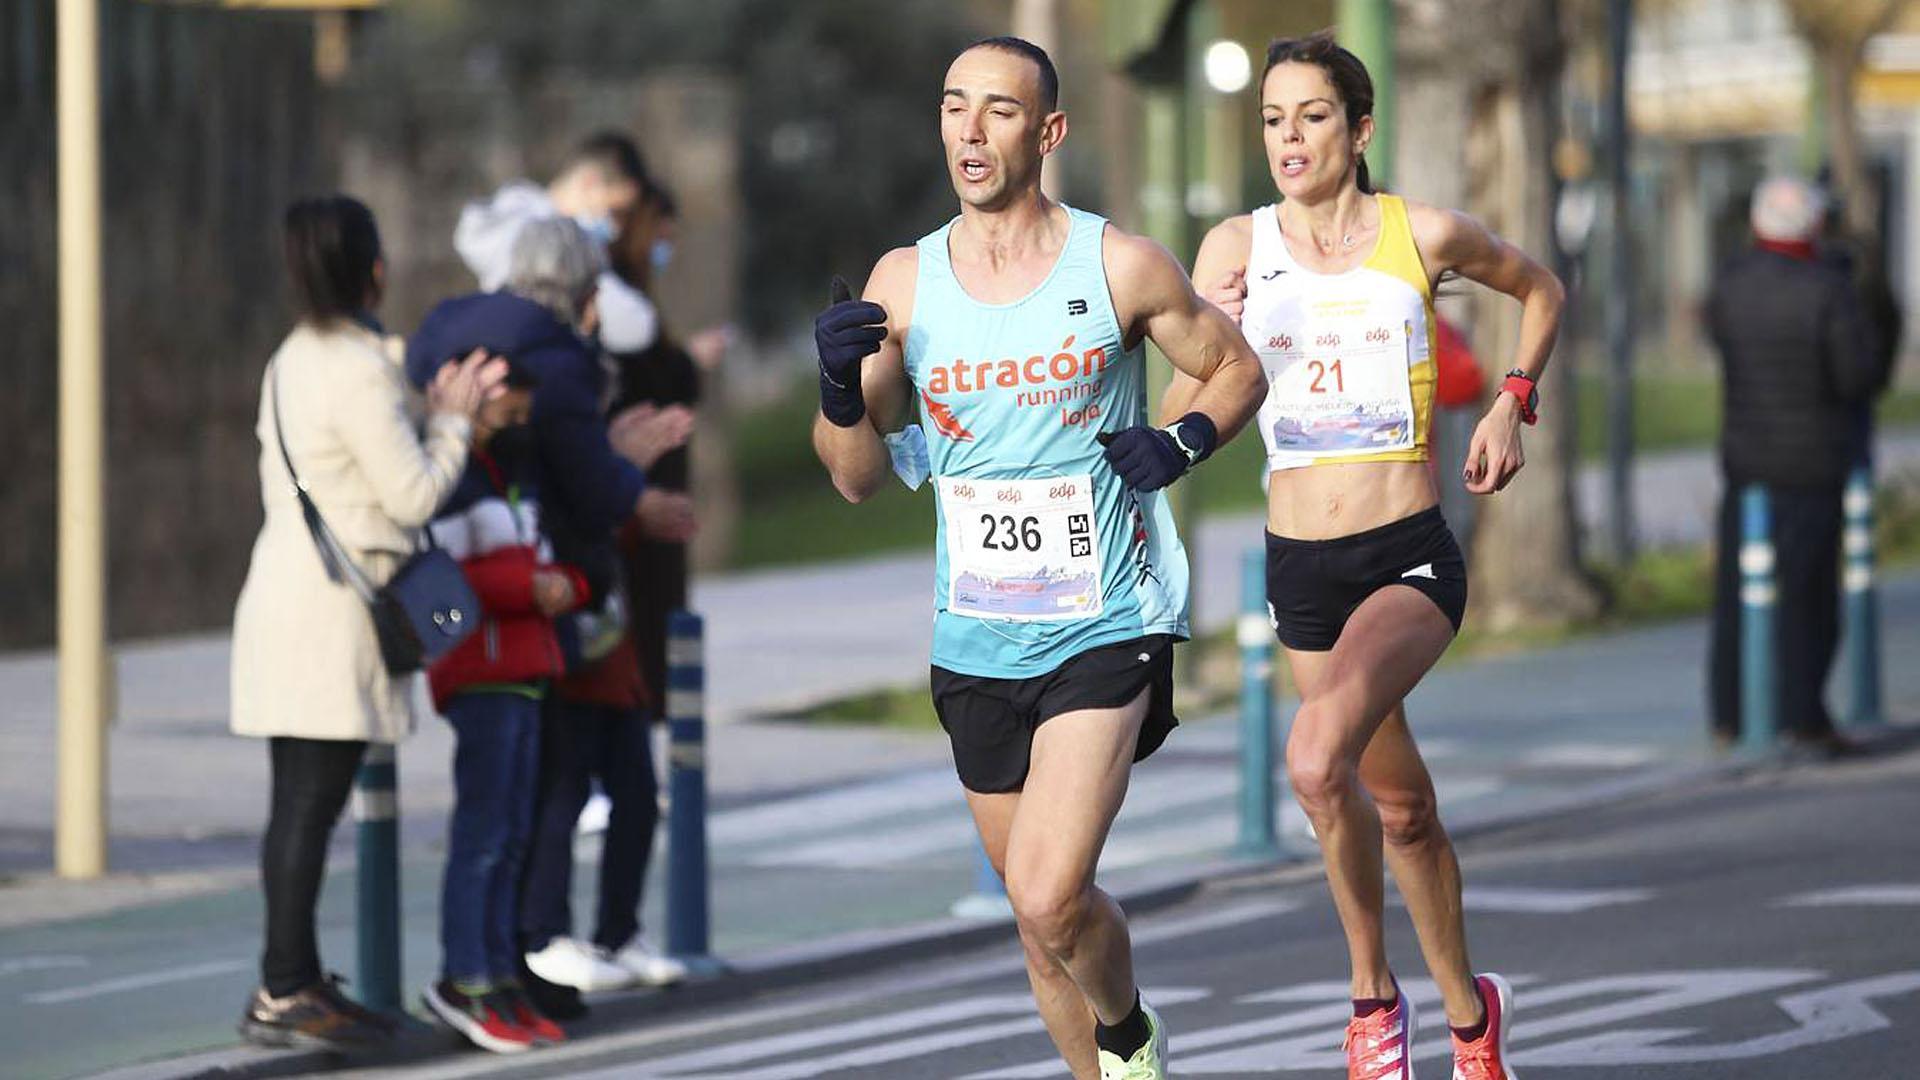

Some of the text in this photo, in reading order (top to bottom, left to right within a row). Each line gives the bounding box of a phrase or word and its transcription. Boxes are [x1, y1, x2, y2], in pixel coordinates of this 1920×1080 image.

[1269, 327, 1391, 351] edp edp edp
[928, 335, 1106, 395] atracón
[1307, 358, 1345, 394] 21
[1017, 379, 1102, 408] running
[1061, 403, 1102, 430] loja
[954, 482, 1077, 505] edp edp edp
[980, 513, 1042, 552] 236
